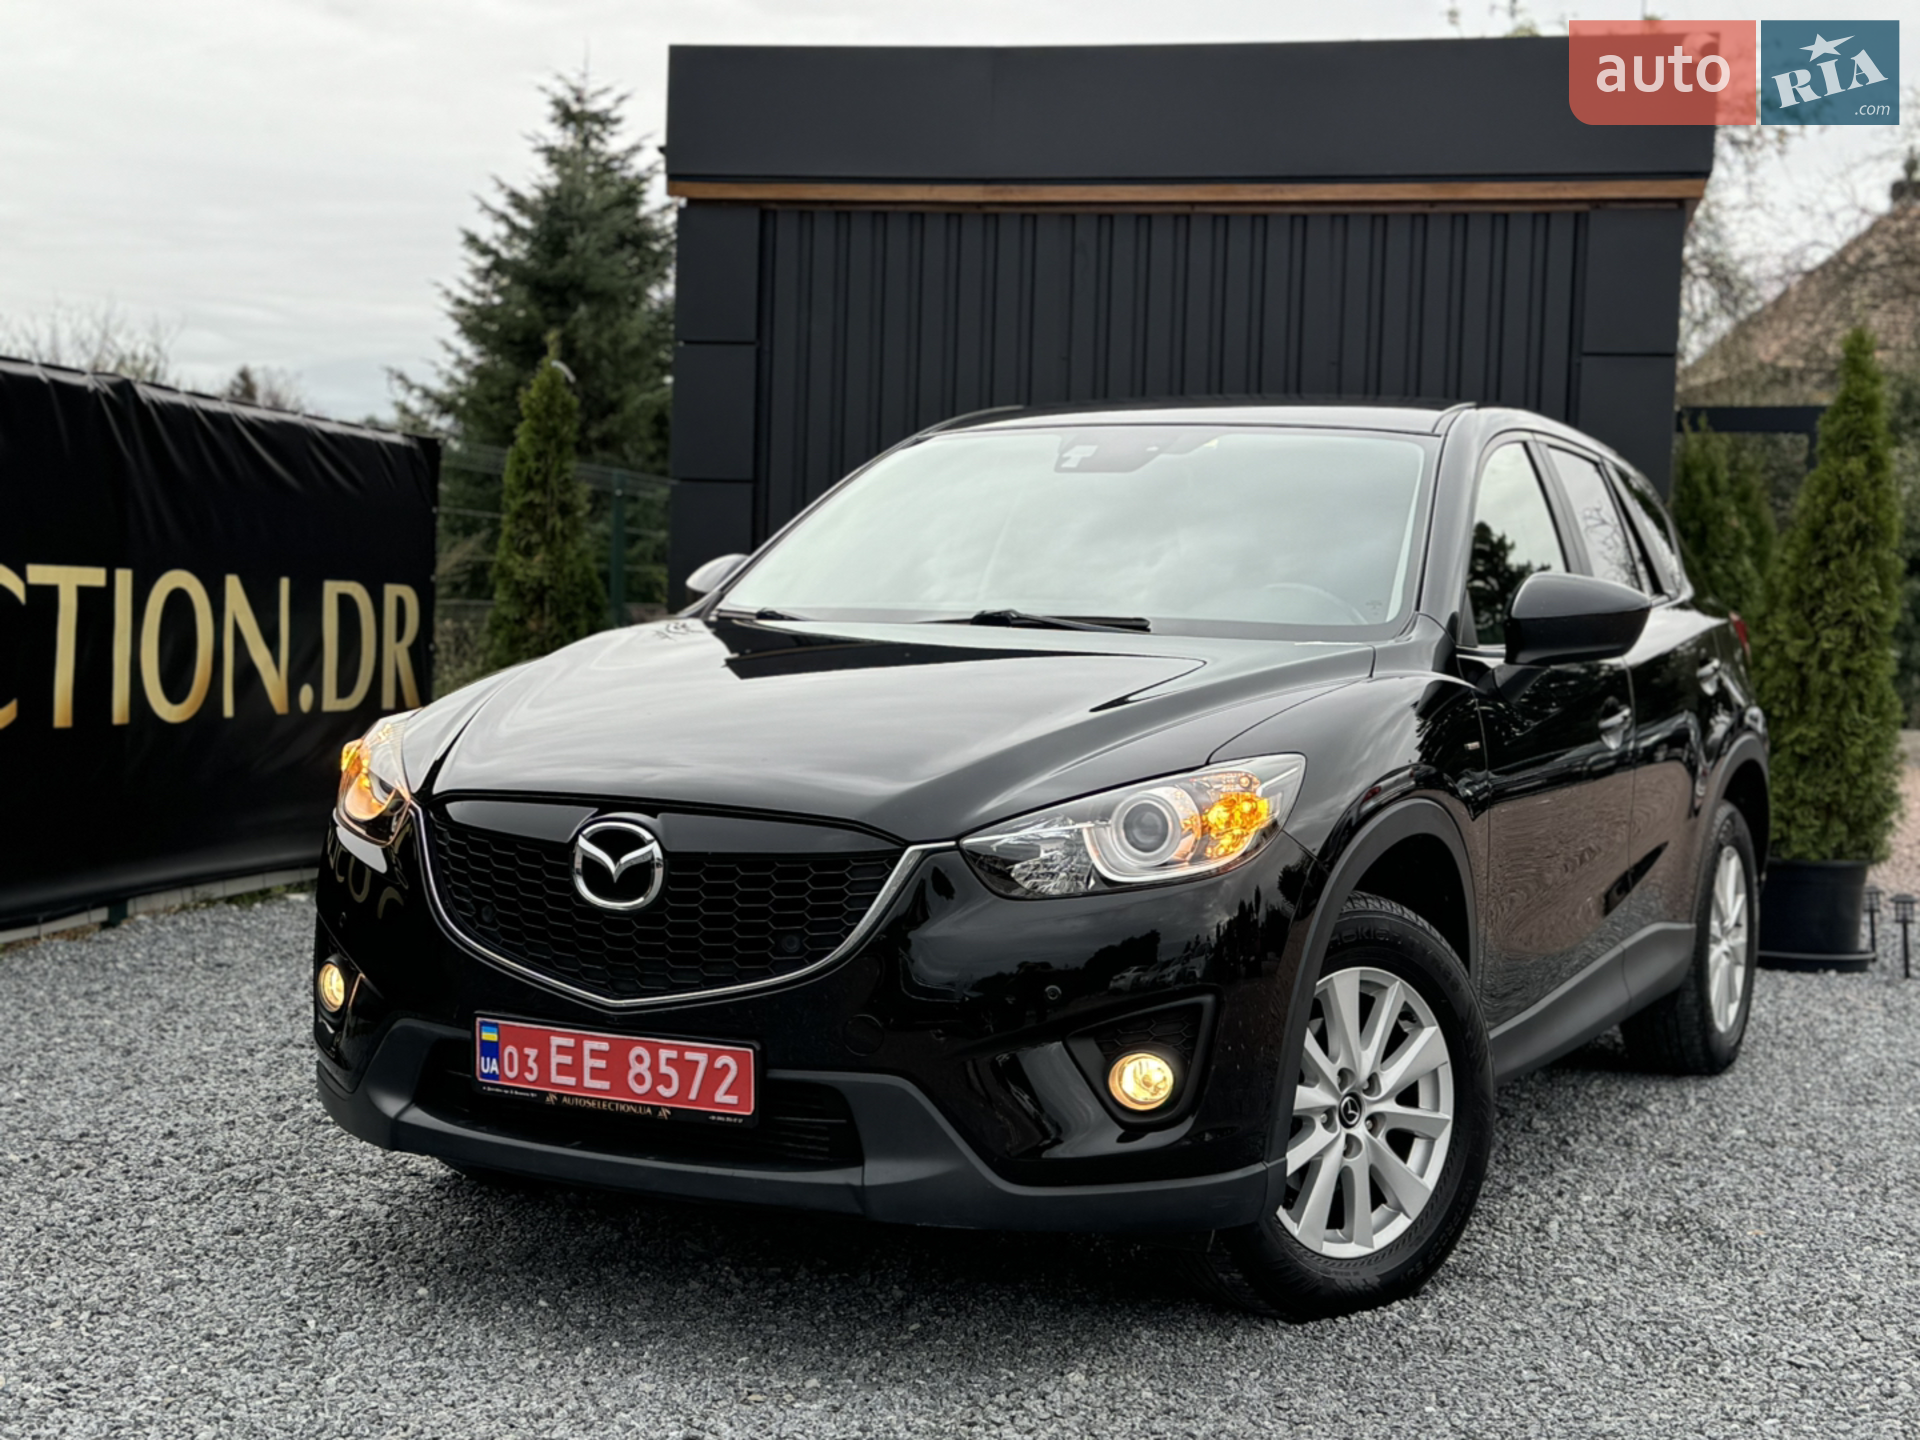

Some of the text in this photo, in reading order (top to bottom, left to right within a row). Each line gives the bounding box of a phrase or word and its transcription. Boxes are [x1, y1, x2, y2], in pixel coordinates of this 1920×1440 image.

[481, 1056, 499, 1076] UA
[503, 1035, 739, 1105] 03 EE 8572
[561, 1095, 652, 1116] AUTOSELECTION.UA
